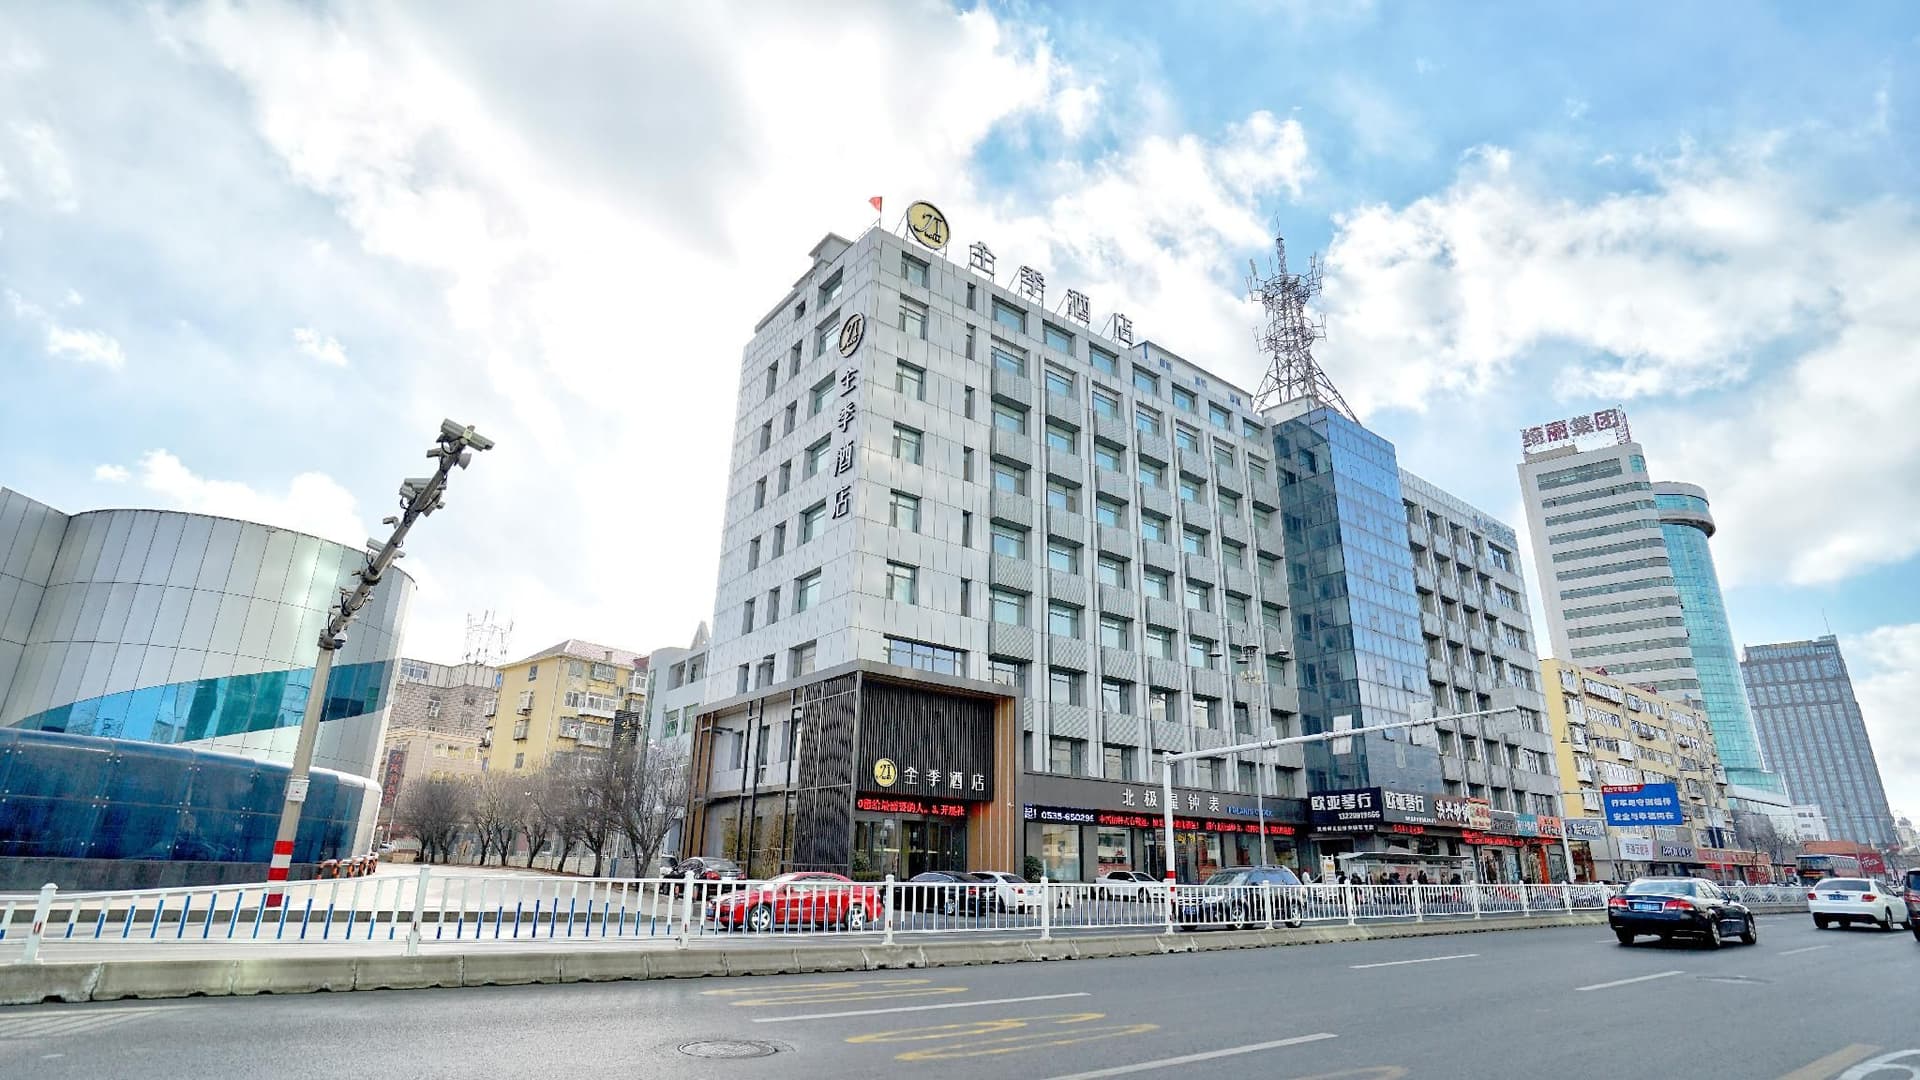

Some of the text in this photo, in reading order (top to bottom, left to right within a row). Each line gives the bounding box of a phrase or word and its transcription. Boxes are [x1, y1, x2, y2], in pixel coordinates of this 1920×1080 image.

[969, 241, 1134, 346] 全季酒店
[831, 367, 859, 520] 全季酒店
[904, 766, 985, 791] 全季酒店
[1122, 788, 1220, 812] 北极星钟表
[1311, 793, 1372, 811] 欧亚琴行
[1384, 790, 1425, 813] 欧亚琴行
